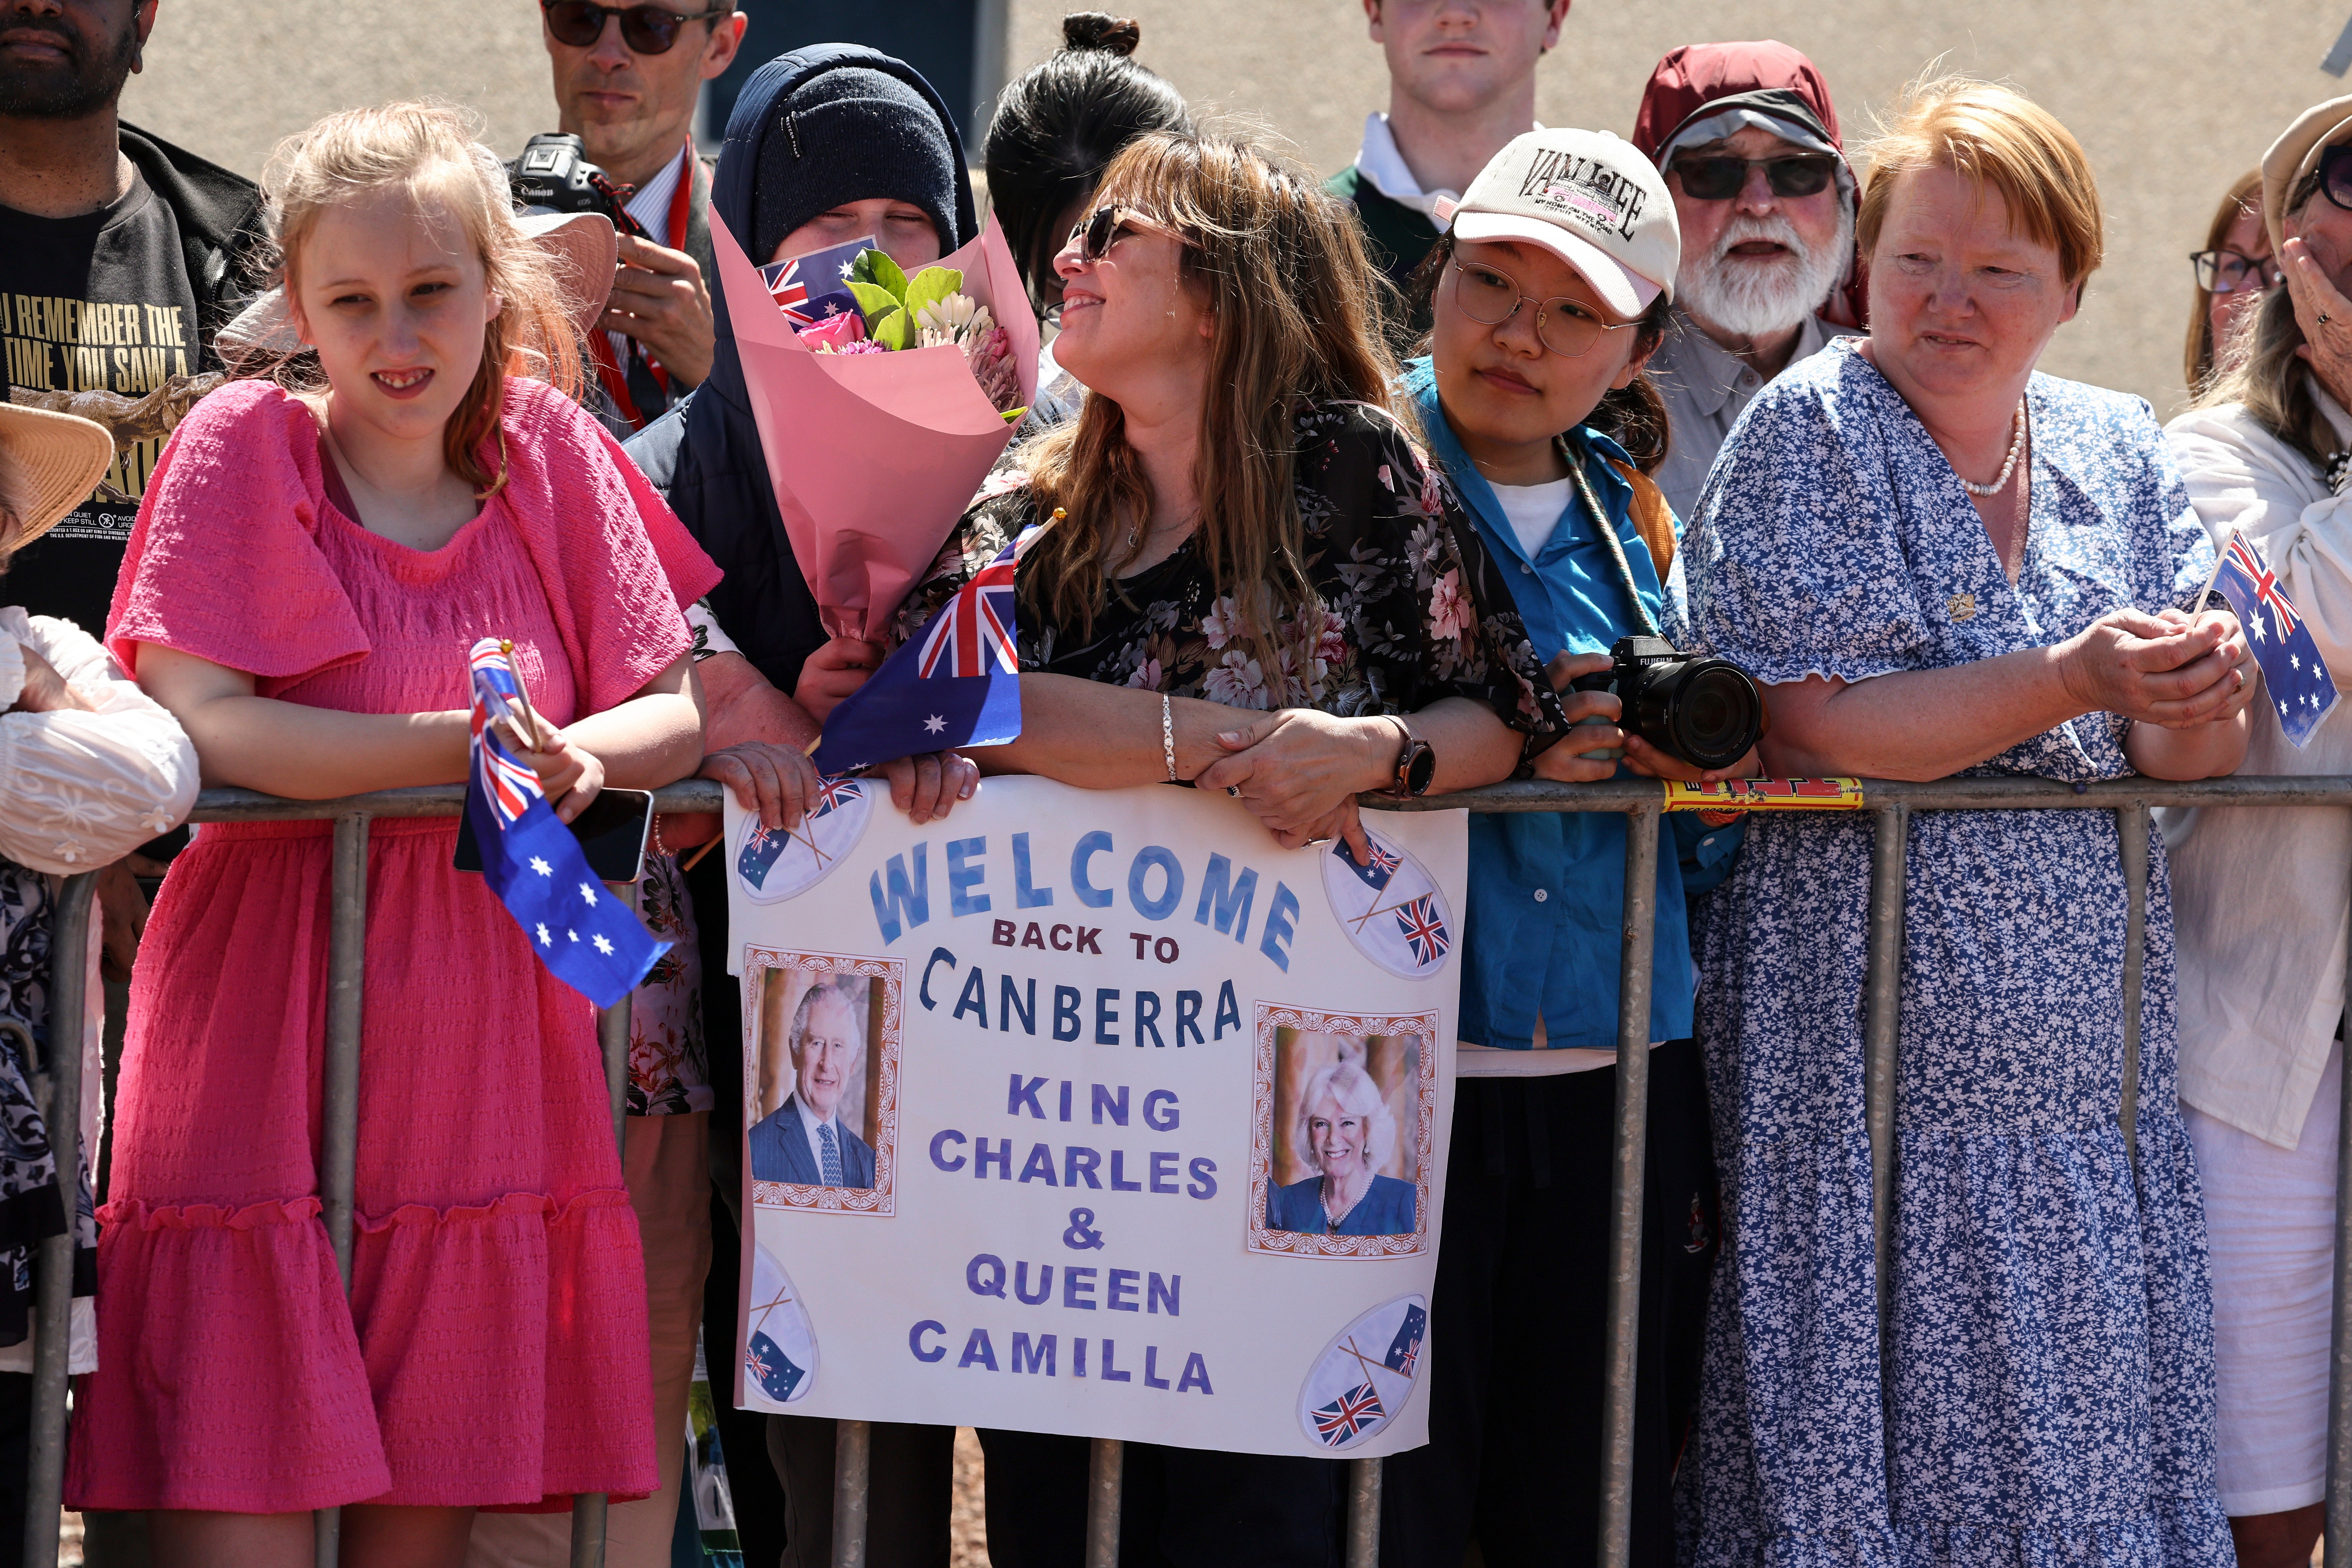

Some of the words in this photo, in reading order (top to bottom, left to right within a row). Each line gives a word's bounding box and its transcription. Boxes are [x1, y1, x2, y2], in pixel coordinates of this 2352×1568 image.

[786, 116, 794, 139] WESTERN
[521, 188, 554, 196] Canon
[1520, 148, 1586, 197] VAN
[577, 198, 591, 206] EOS
[1134, 214, 1149, 223] DKNY
[1583, 212, 1595, 221] THE
[1596, 220, 1612, 235] ROAD
[15, 294, 142, 346] REMEMBER
[144, 303, 186, 347] THE
[2, 336, 55, 390] TIME
[60, 345, 108, 391] YOU
[114, 347, 166, 392] SAW
[869, 831, 1300, 974] WELCOME
[992, 919, 1102, 955] BACK
[1131, 933, 1180, 964] TO
[919, 947, 1241, 1049] CANBERRA
[1007, 1073, 1180, 1132] KING
[929, 1129, 1218, 1200] CHARLES
[1063, 1207, 1105, 1250] &
[966, 1254, 1181, 1316] QUEEN
[909, 1319, 1214, 1395] CAMILLA
